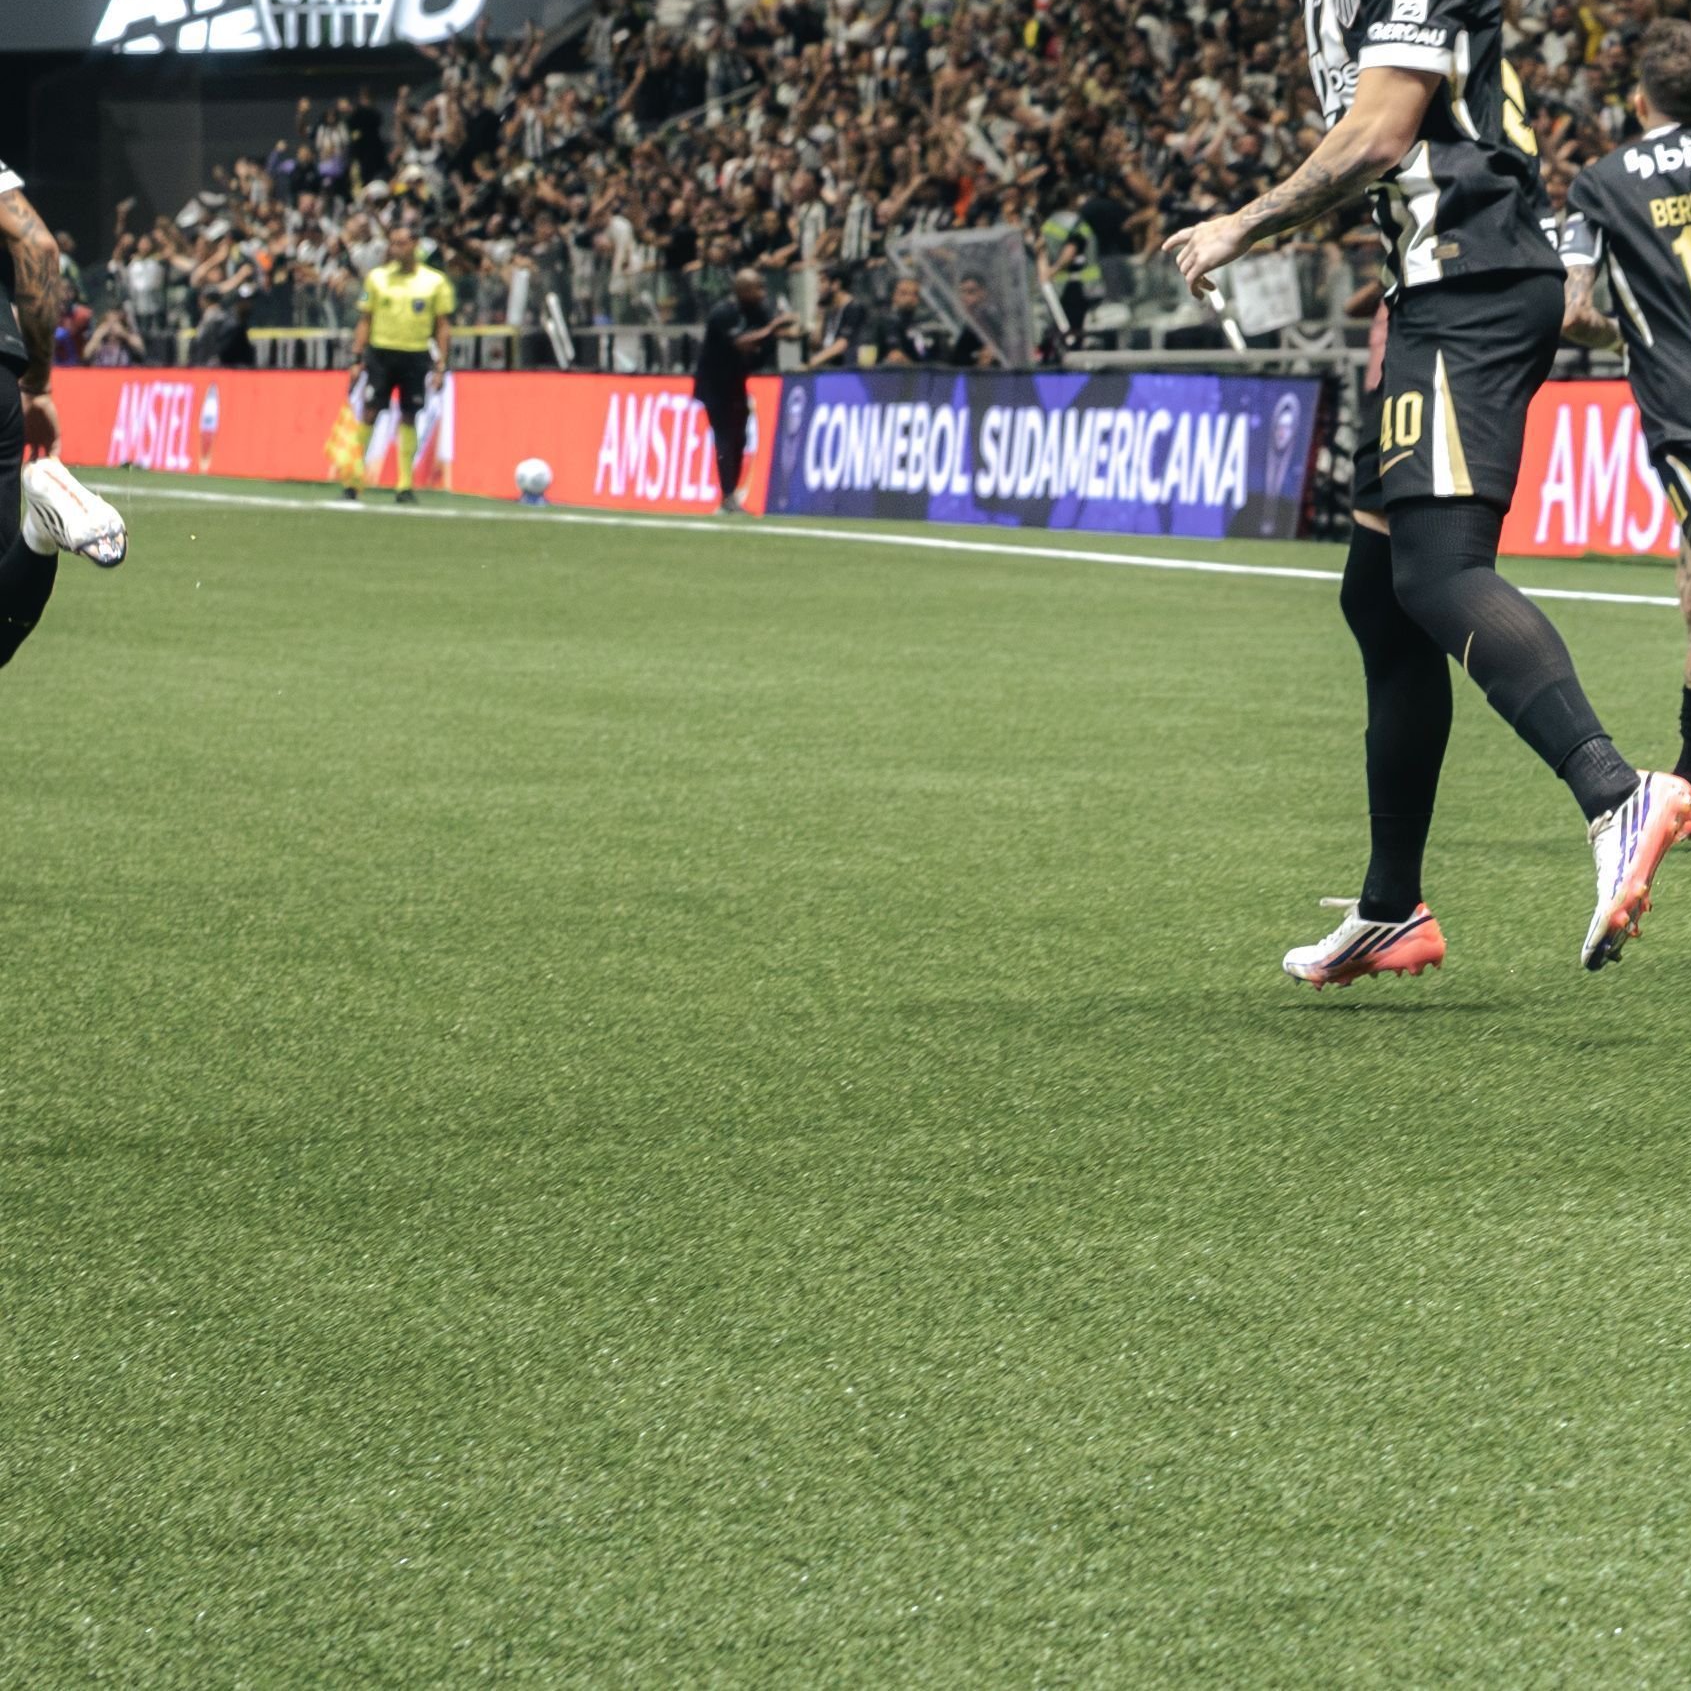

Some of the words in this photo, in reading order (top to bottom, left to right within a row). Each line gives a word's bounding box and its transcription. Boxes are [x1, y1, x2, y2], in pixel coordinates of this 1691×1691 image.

[1367, 21, 1448, 47] GERDAU
[106, 381, 193, 469] AMSTEL
[593, 391, 718, 501] AMSTEL
[805, 402, 968, 495] CONMEBOL
[975, 406, 1249, 509] SUDAMERICANA
[1535, 404, 1682, 551] AMS
